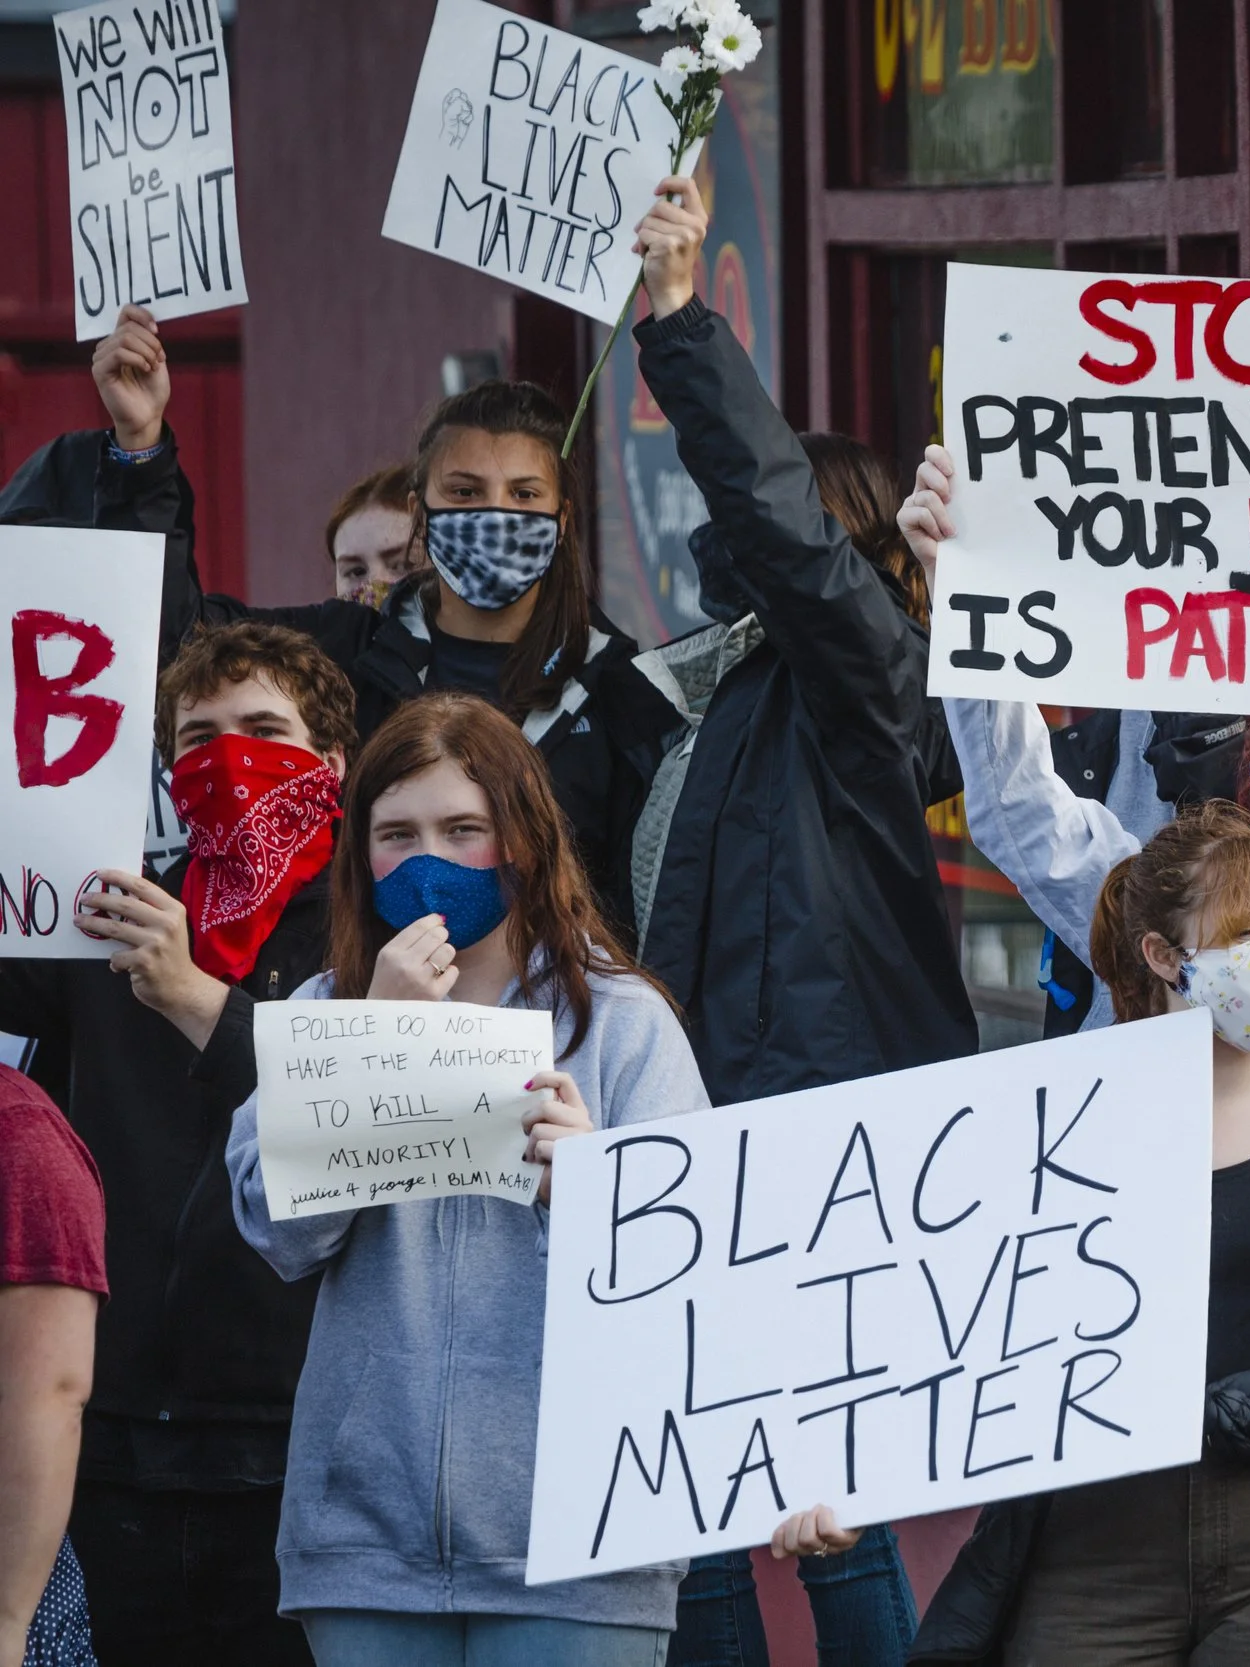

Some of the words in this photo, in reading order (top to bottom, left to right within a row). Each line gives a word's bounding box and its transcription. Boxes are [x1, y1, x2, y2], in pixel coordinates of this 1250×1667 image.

[77, 47, 219, 170] NOT
[490, 20, 644, 142] BLACK
[129, 161, 163, 195] be
[482, 104, 631, 230] LIVES
[77, 166, 233, 317] SILENT
[434, 174, 607, 302] MATTER
[1034, 491, 1219, 572] YOUR
[949, 590, 1073, 678] IS
[286, 1056, 338, 1080] HAVE
[361, 1053, 408, 1071] THE
[429, 1047, 543, 1067] AUTHORITY
[290, 1015, 376, 1042] POLICE
[397, 1014, 425, 1037] DO
[445, 1017, 492, 1034] NOT
[305, 1099, 350, 1128] TO
[370, 1094, 439, 1122] KILL
[473, 1092, 491, 1114] A
[290, 1188, 342, 1214] justice
[347, 1181, 360, 1197] 4
[447, 1170, 492, 1189] BLM!
[587, 1078, 1118, 1304] BLACK
[685, 1216, 1141, 1415] LIVES
[590, 1350, 1131, 1558] MATTER
